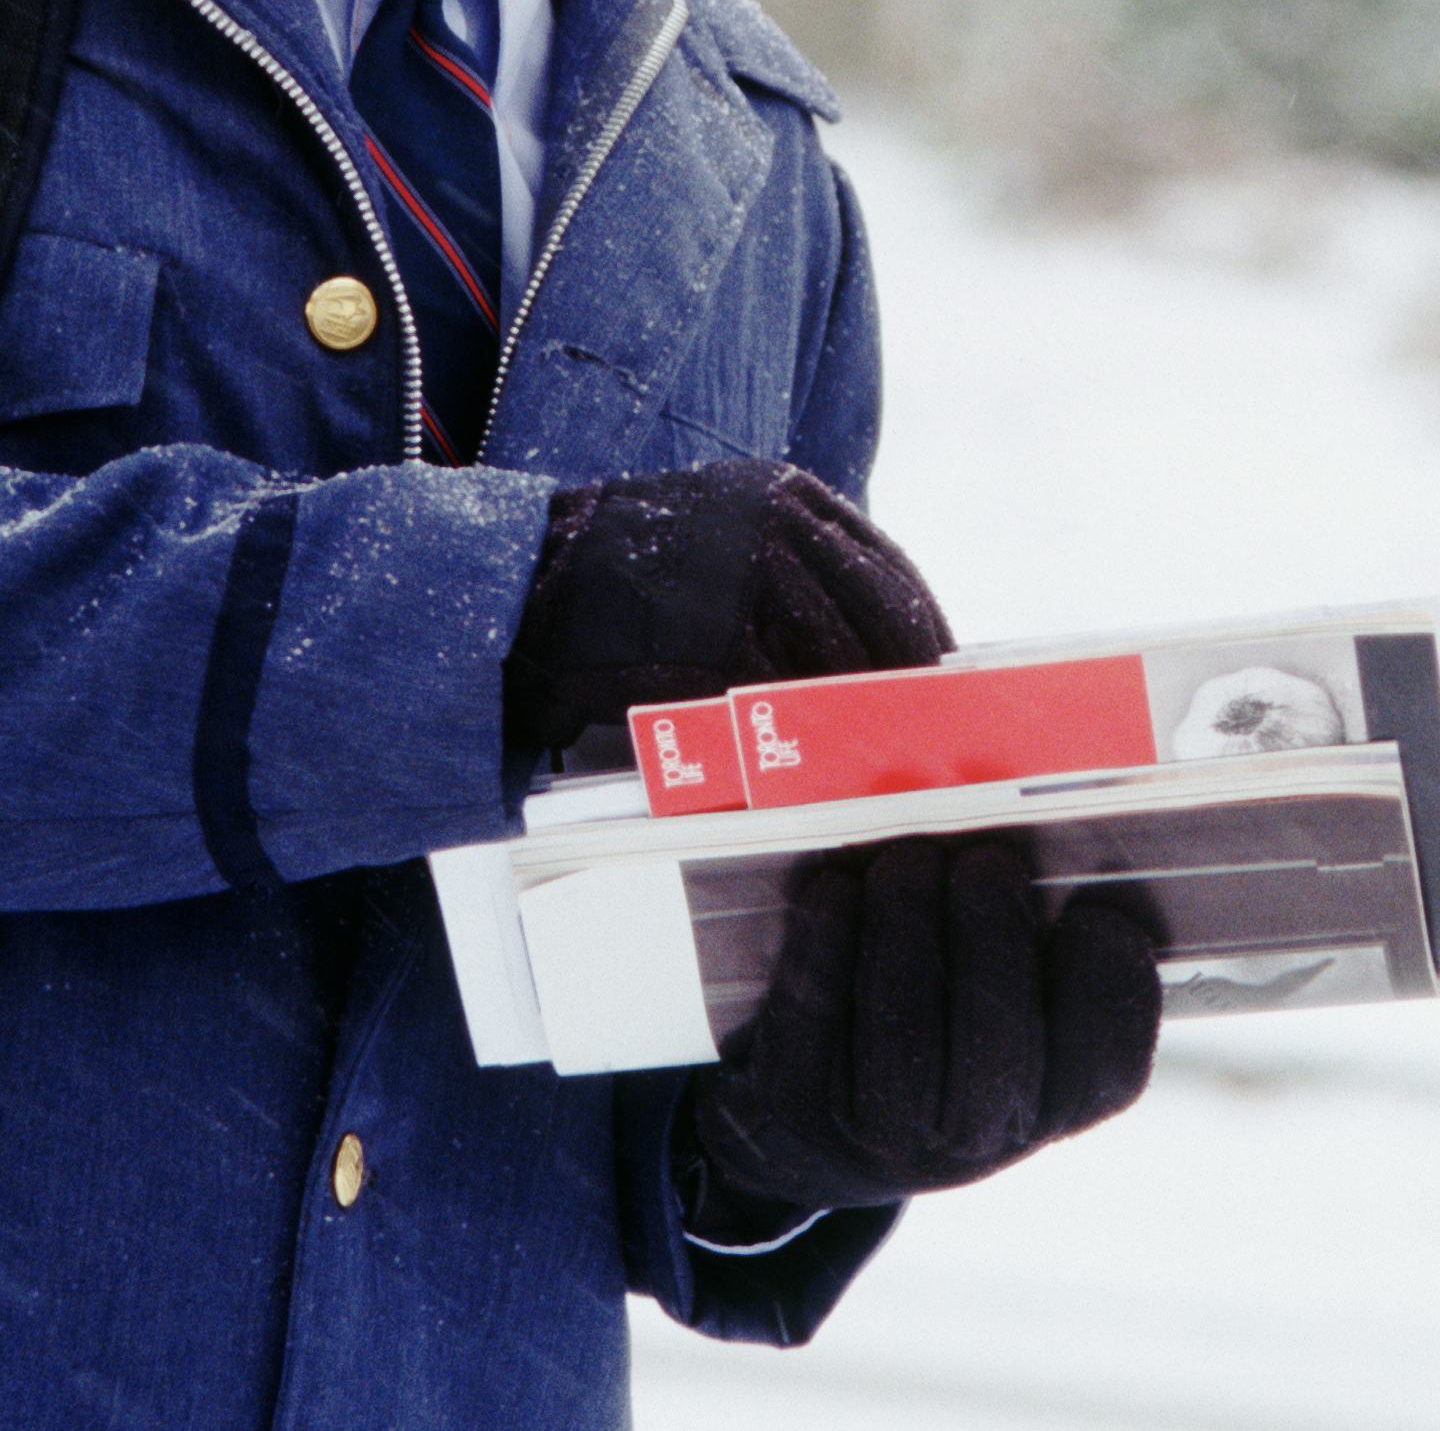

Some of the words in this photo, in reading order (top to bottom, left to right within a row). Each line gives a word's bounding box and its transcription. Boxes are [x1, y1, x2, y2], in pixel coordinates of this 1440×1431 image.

[652, 718, 683, 788] TORONTO
[750, 701, 779, 771] TORONTO
[778, 738, 801, 767] LIFE
[682, 762, 704, 785] LIFE
